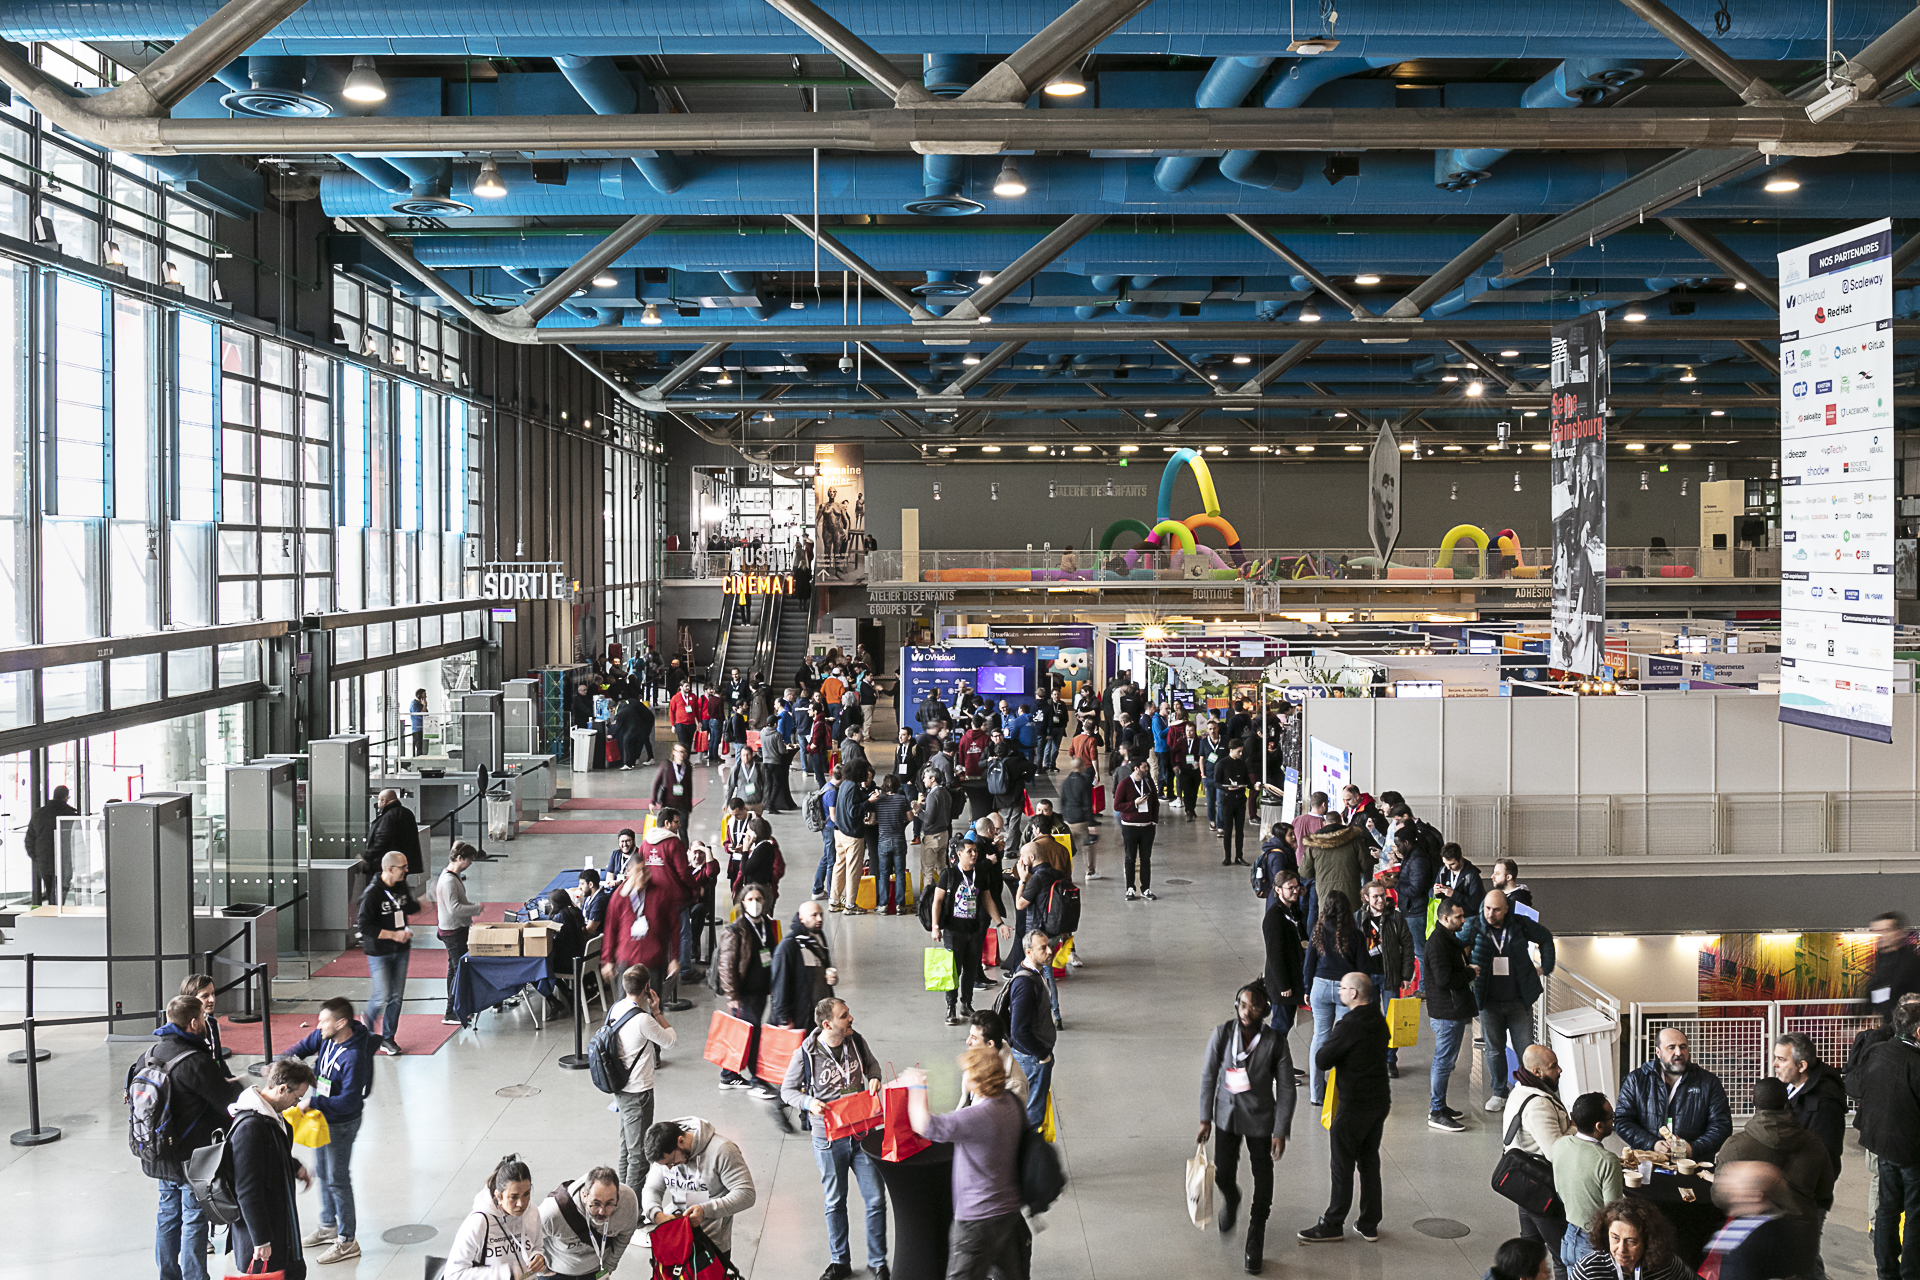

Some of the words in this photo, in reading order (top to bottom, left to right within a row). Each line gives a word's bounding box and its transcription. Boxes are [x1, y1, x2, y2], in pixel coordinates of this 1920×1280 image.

[1819, 256, 1833, 268] NOS
[1834, 241, 1879, 264] PARTENAIRES
[1850, 274, 1884, 291] Scaleway
[1797, 288, 1826, 305] OVHcloud
[1827, 305, 1840, 318] Red
[1840, 304, 1852, 315] Hat
[1841, 346, 1857, 356] solo.io
[1868, 340, 1885, 351] GitLab
[1800, 360, 1812, 368] SUSE
[1552, 392, 1577, 418] Serge
[1846, 407, 1869, 416] LACEWORK
[1552, 415, 1603, 443] Gainsbourg
[1788, 449, 1807, 458] deezer
[749, 463, 772, 481] BPI
[1091, 486, 1108, 497] DES
[1111, 486, 1147, 497] ENFANTS
[484, 572, 565, 600] SORTIE
[722, 572, 783, 595] CINÉMA
[786, 575, 794, 595] 1
[869, 591, 901, 602] ATELIER
[902, 591, 919, 601] DES
[920, 591, 955, 601] ENFANTS
[1192, 589, 1234, 600] BOUTIQUE
[869, 605, 907, 615] GROUPES
[1843, 614, 1871, 622] Communautaire
[924, 653, 956, 661] OVHcloud
[1611, 652, 1624, 667] Labs
